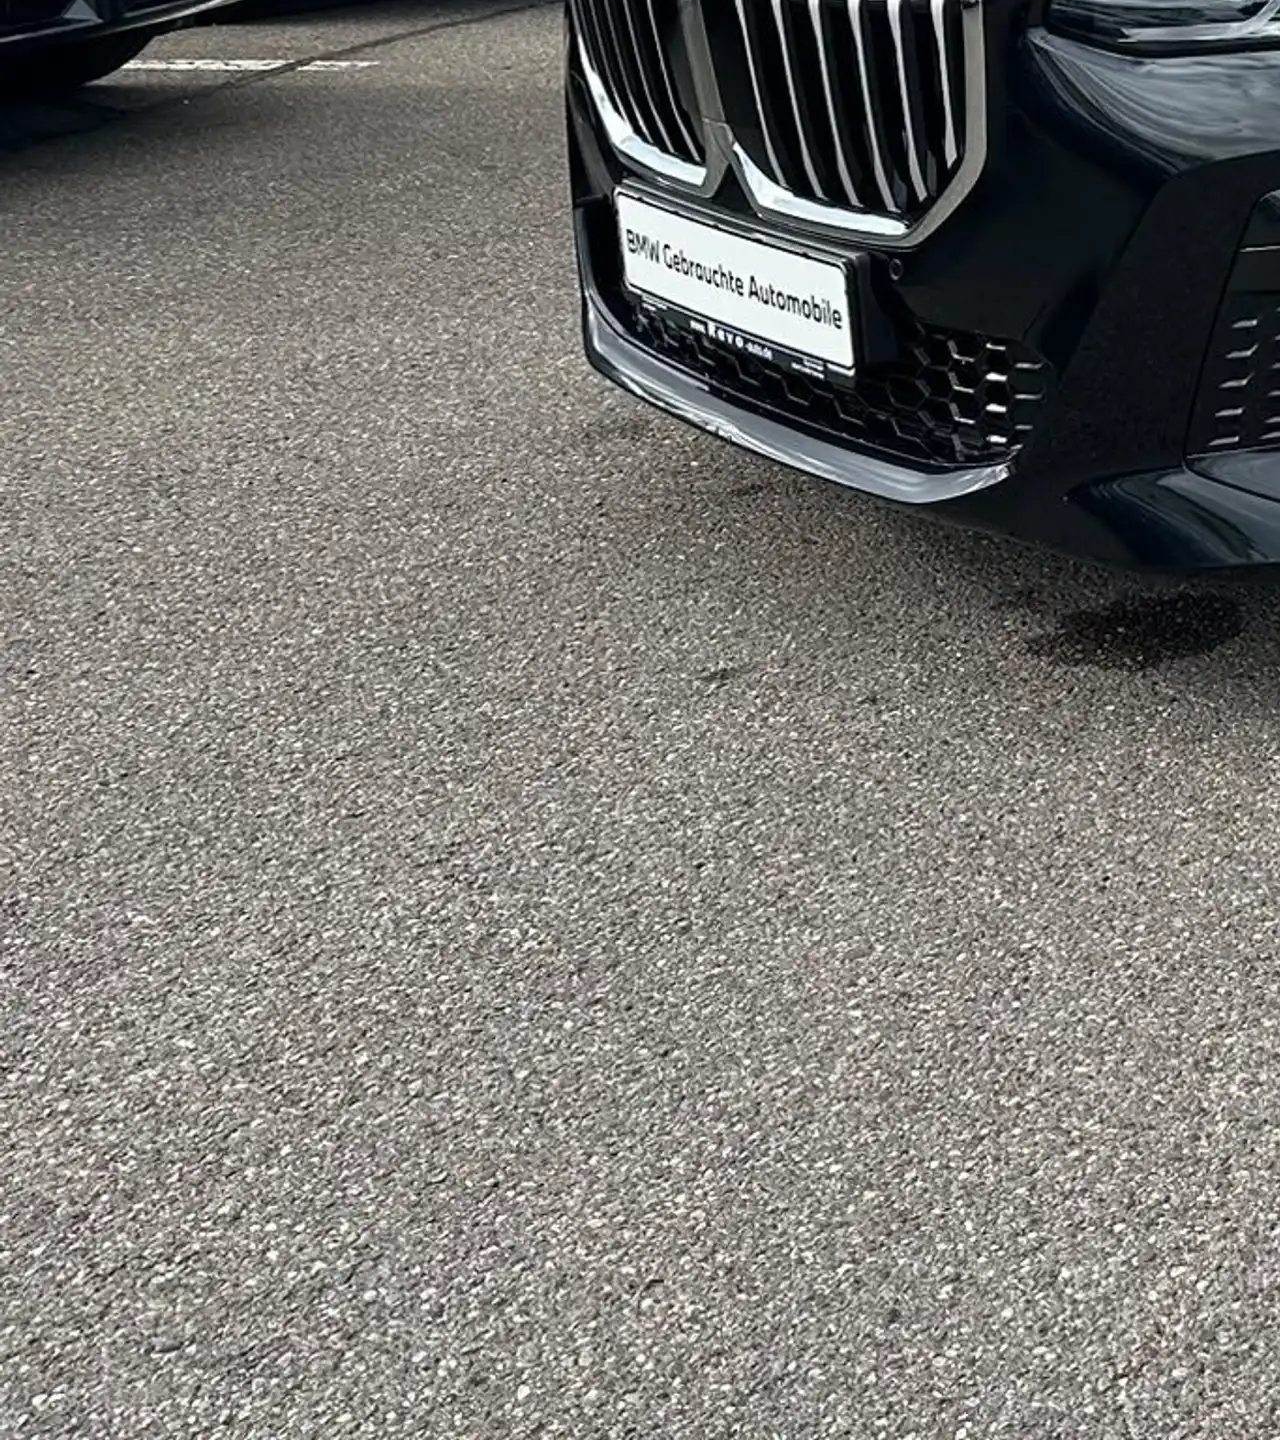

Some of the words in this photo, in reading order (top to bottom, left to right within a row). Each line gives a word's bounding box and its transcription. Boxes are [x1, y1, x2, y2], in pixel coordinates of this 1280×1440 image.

[626, 228, 660, 265] BMW
[662, 243, 745, 298] Gebrauchte
[747, 274, 843, 330] Automobile
